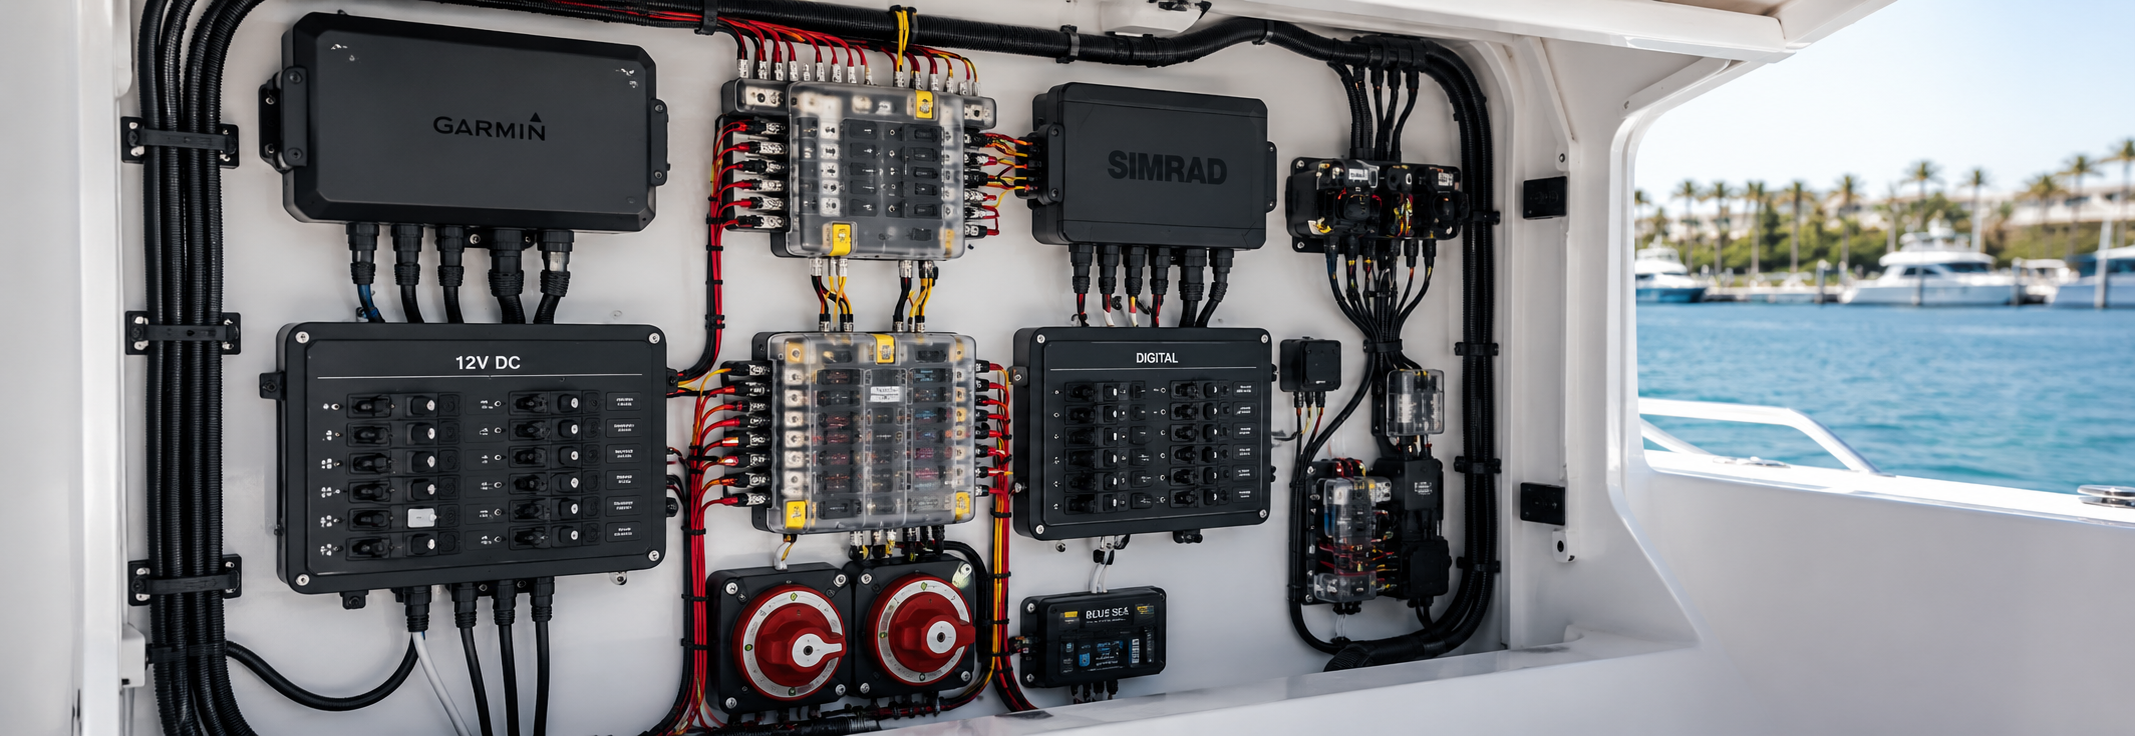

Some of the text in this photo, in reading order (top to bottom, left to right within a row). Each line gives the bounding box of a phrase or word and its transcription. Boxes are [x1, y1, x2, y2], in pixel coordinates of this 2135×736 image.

[433, 115, 546, 141] GARMIN
[1107, 150, 1227, 185] SIMRAD
[455, 355, 521, 371] 12V DC
[1136, 352, 1179, 364] DIGITAL
[1086, 606, 1129, 619] BLUE SEA
